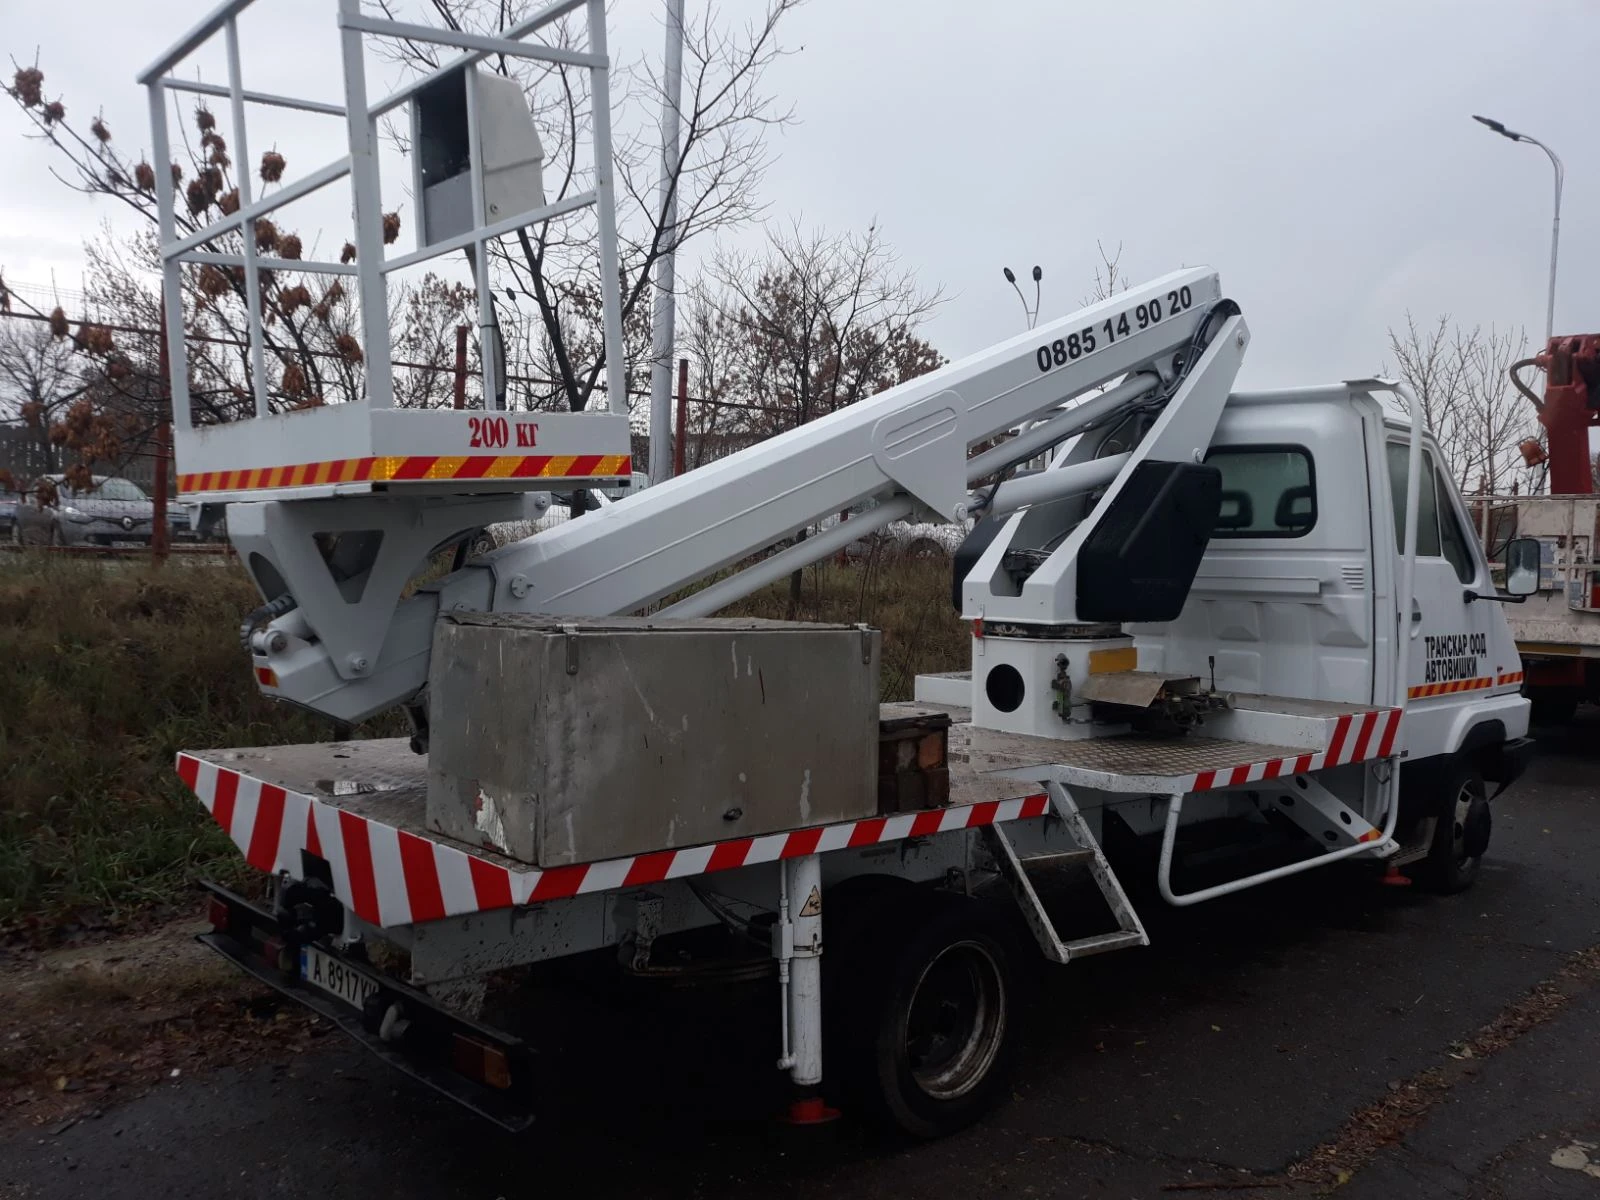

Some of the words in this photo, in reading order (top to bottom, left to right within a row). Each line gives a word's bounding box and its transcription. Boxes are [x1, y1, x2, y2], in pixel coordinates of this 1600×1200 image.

[1036, 326, 1096, 373] 0885
[1103, 312, 1131, 343] 14
[1135, 298, 1162, 329] 90
[1167, 285, 1192, 316] 20
[468, 416, 509, 448] 200
[1424, 634, 1468, 659] ТРАНСКАР
[1469, 632, 1487, 658] ООД
[1425, 656, 1478, 683] АВТОВИШКИ
